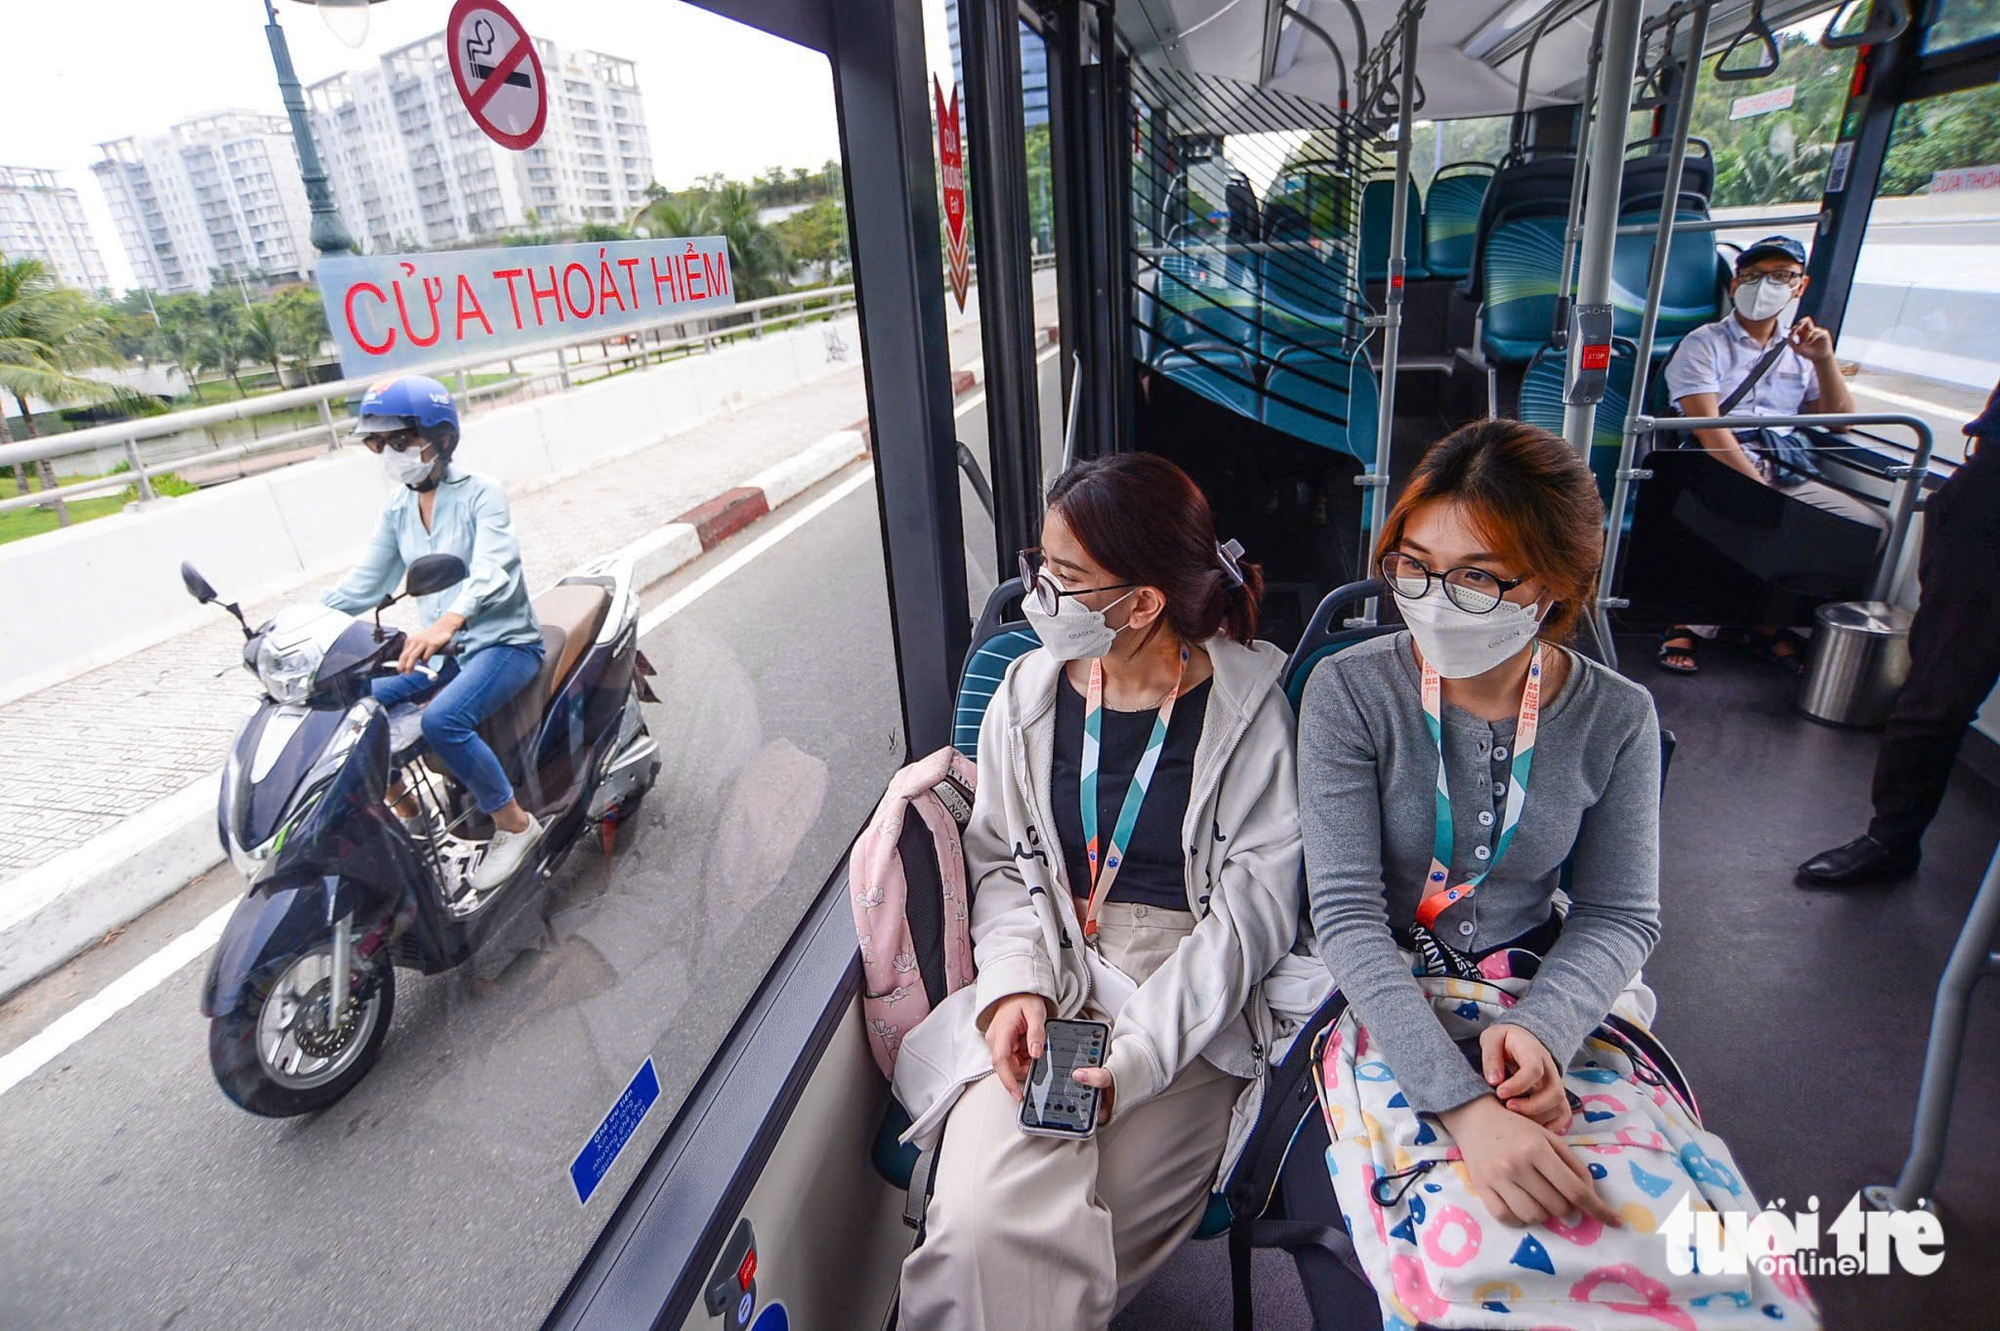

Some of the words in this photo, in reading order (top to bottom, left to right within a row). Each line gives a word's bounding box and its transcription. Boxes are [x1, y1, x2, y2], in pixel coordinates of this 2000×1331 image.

[344, 262, 494, 356] CỬA
[493, 247, 640, 330] THOÁT
[651, 242, 729, 306] HIỂM
